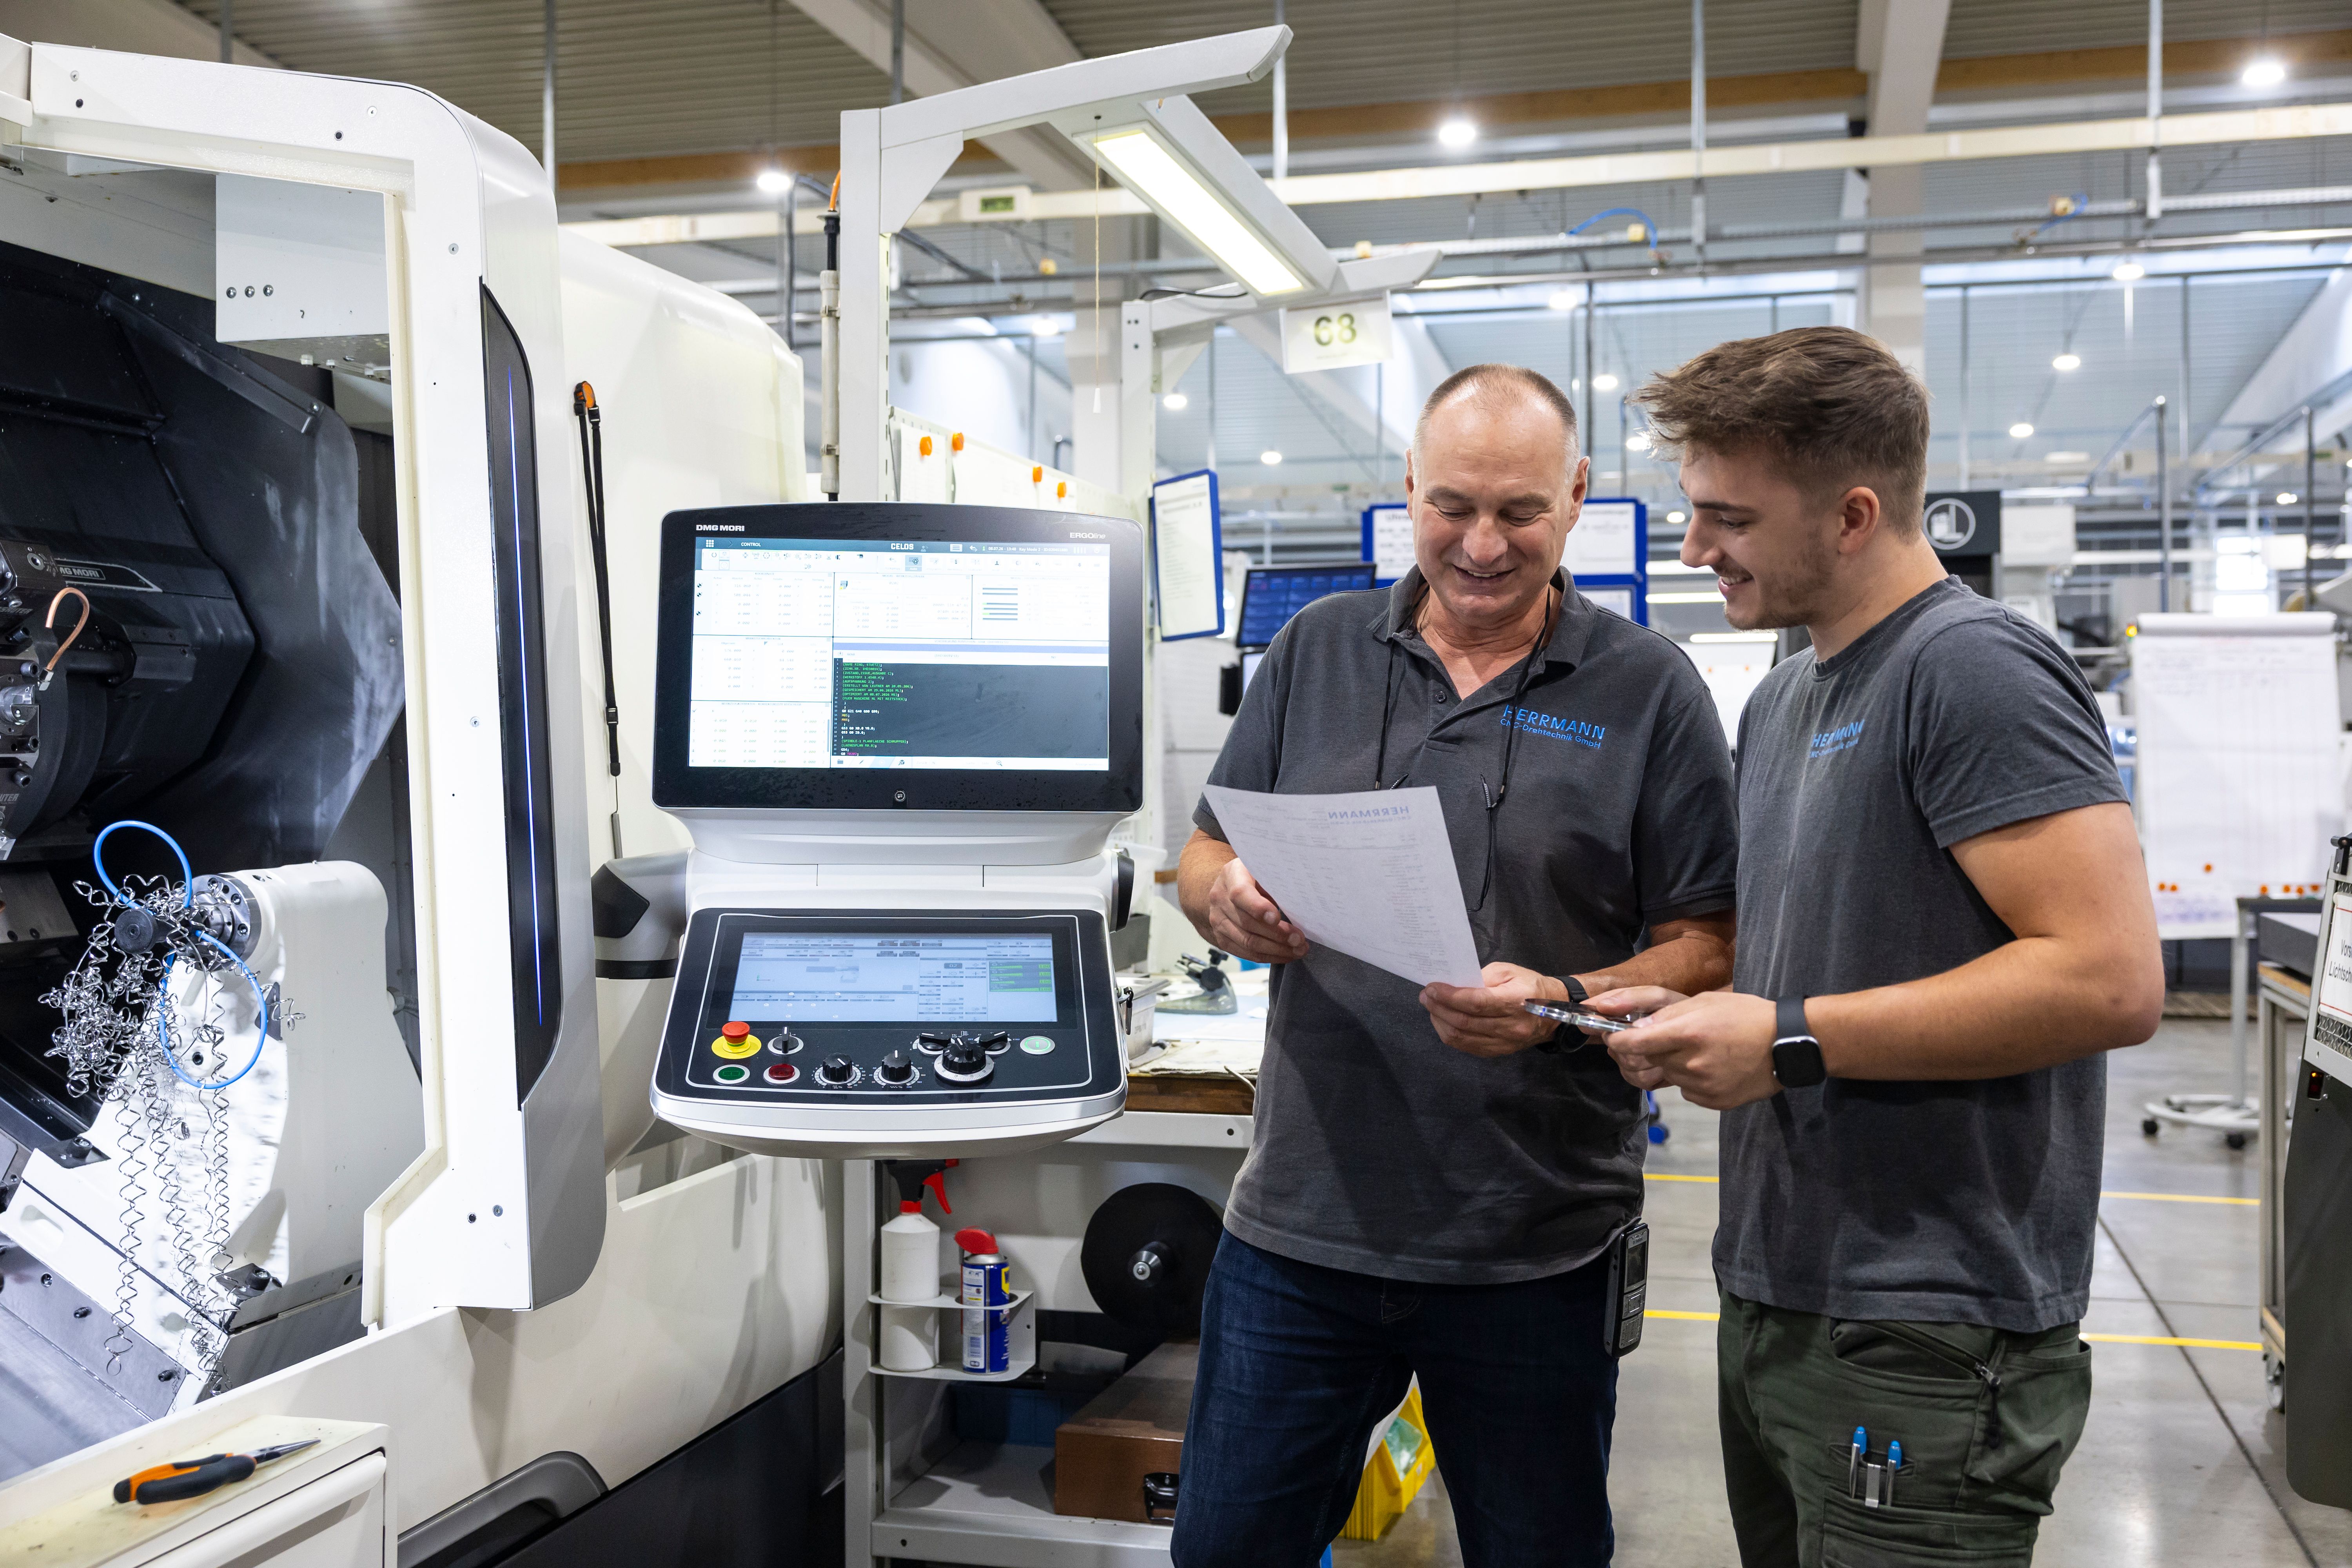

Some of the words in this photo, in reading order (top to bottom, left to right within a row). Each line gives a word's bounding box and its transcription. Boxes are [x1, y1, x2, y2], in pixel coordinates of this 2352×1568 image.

[1314, 312, 1357, 346] 68
[60, 567, 73, 575] MG
[73, 568, 100, 578] MORI
[1503, 705, 1605, 740] HERRMANN
[1575, 735, 1601, 749] GmbH
[2329, 961, 2352, 984] Lichtsch
